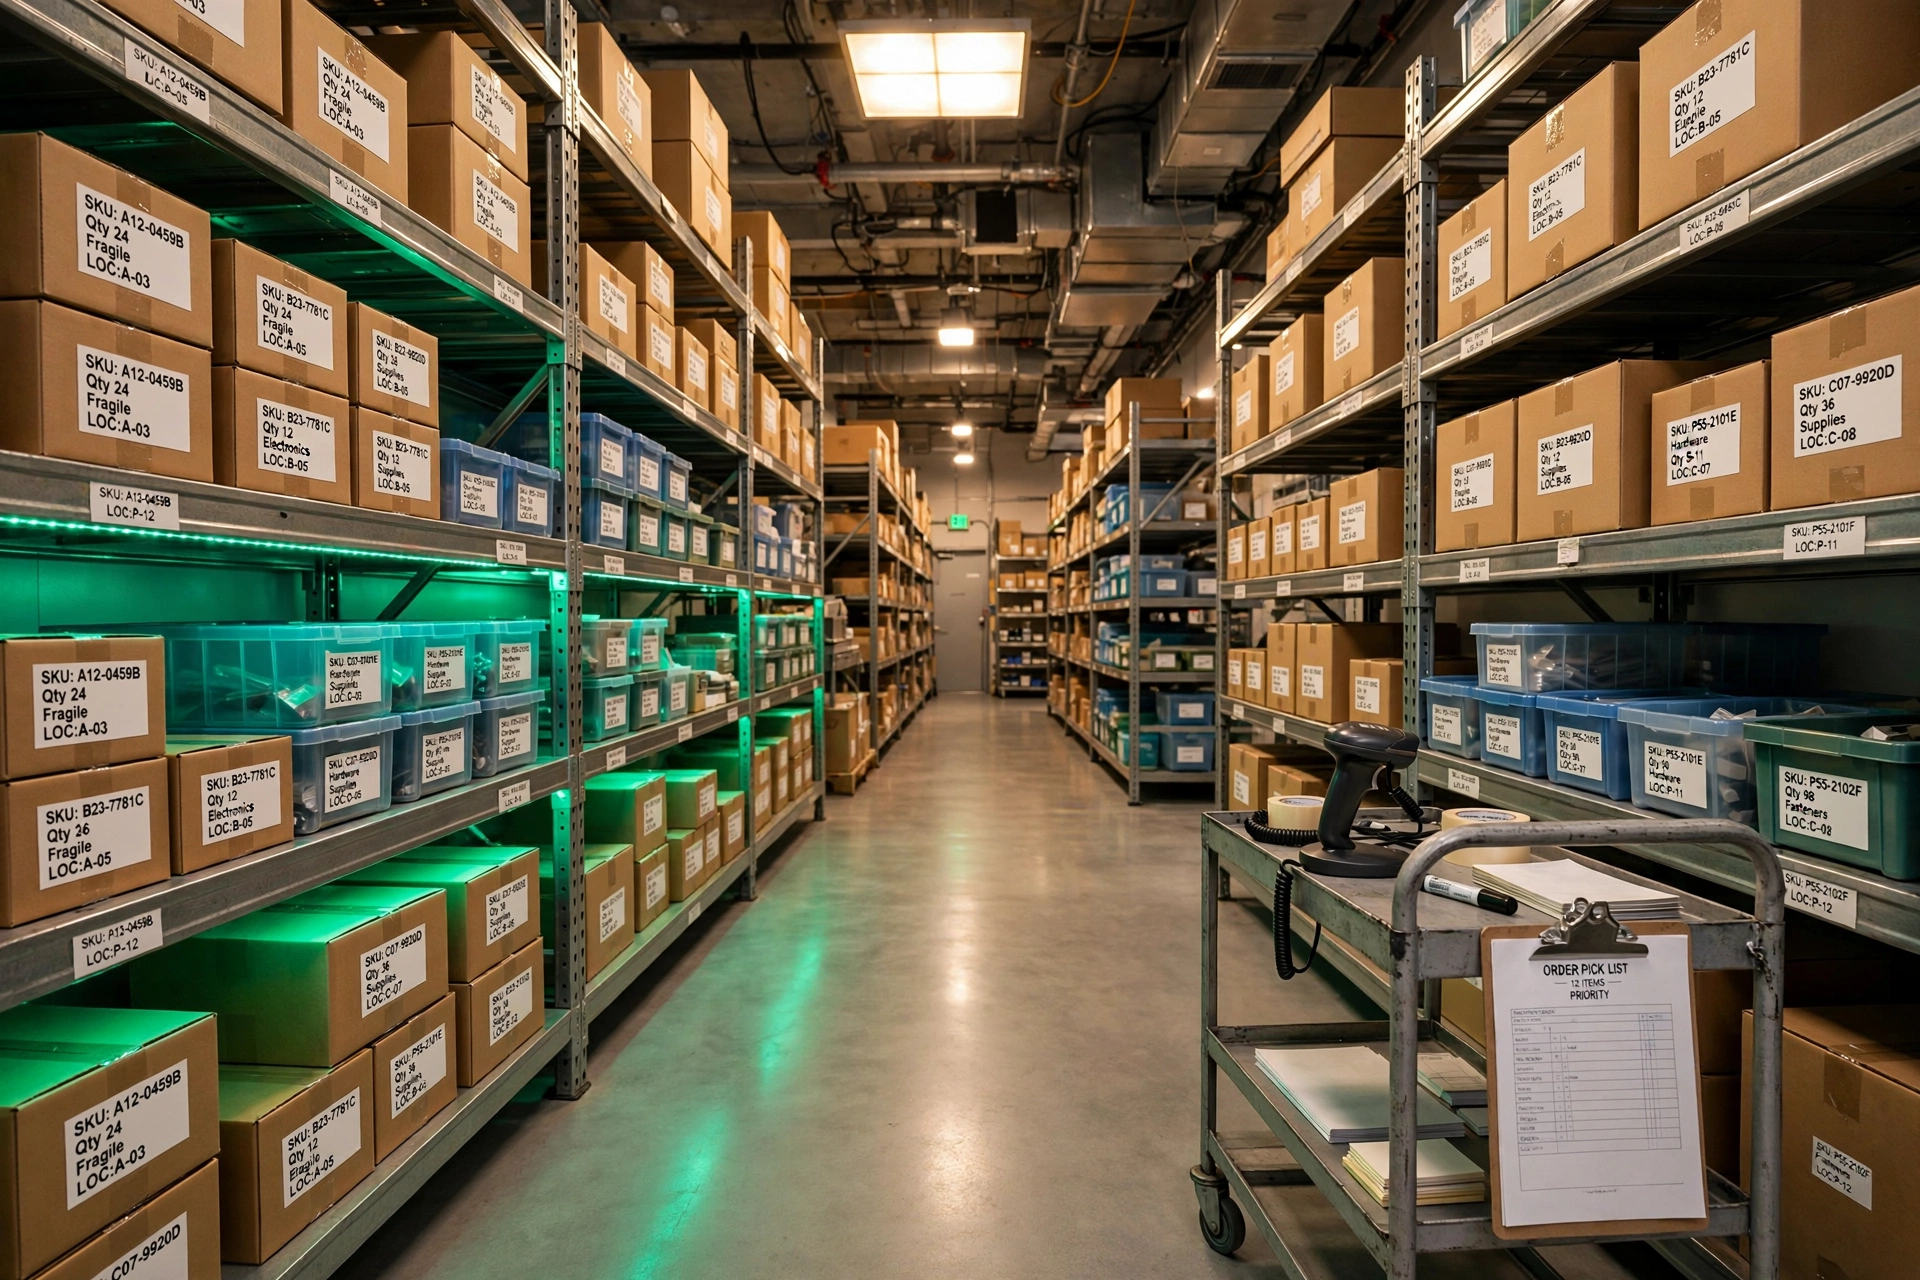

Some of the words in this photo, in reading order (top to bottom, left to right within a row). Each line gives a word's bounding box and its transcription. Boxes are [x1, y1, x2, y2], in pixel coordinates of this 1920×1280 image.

[134, 48, 157, 71] SKU:
[323, 57, 343, 82] SKU:
[1675, 81, 1696, 102] SKU:
[1698, 41, 1750, 86] B23-7781C
[323, 73, 338, 94] Qty
[341, 88, 350, 101] 24
[1694, 90, 1703, 106] 12
[323, 104, 364, 140] LOC:A-03
[1675, 110, 1721, 148] LOC:B-05
[85, 194, 117, 220] SKU:
[121, 211, 184, 248] A12-0459B
[86, 214, 109, 238] Qty
[114, 226, 129, 243] 24
[87, 234, 130, 262] Fragile
[87, 253, 150, 288] LOC:A-03
[262, 283, 285, 302] SKU:
[287, 294, 329, 320] B23-7781C
[262, 300, 278, 317] Qty
[281, 308, 292, 320] 24
[263, 315, 293, 336] Fragile
[263, 331, 306, 355] LOC:A-05
[86, 354, 117, 375] SKU:
[122, 364, 184, 392] A12-0459B
[86, 373, 110, 394] Qty
[115, 381, 129, 396] 24
[1799, 384, 1825, 401] SKU:
[1829, 364, 1894, 392] C07-9920D
[87, 392, 131, 415] Fragile
[1800, 404, 1818, 417] Qty
[1822, 398, 1834, 411] 36
[88, 411, 150, 438] LOC:A-03
[262, 405, 285, 422] SKU:
[288, 412, 330, 433] B23-7781C
[263, 421, 279, 437] Qty
[282, 426, 293, 438] 12
[1800, 414, 1845, 433] Supplies
[1800, 427, 1856, 450] LOC:C-08
[264, 453, 308, 471] LOC:B-05
[392, 454, 399, 464] 12
[1672, 463, 1710, 480] LOC:C-07
[99, 487, 123, 500] SKU:
[107, 505, 155, 521] LOC:P-12
[1796, 540, 1837, 552] LOC:P-11
[41, 669, 74, 684] SKU:
[78, 667, 140, 682] A12-0459B
[42, 689, 66, 705] Qty
[71, 688, 86, 701] 24
[43, 706, 88, 722] Fragile
[44, 721, 107, 740] LOC:A-03
[207, 777, 229, 791] SKU:
[232, 766, 275, 786] B23-7781C
[1650, 782, 1683, 798] LOC:P-11
[1785, 772, 1807, 786] SKU:
[1810, 776, 1862, 797] P55-2102F
[208, 794, 223, 808] Qty
[227, 790, 237, 801] 12
[1785, 786, 1800, 800] Qty
[1803, 790, 1814, 801] 98
[46, 807, 78, 824] SKU:
[83, 793, 144, 818] B23-7781C
[1786, 800, 1828, 819] Fasteners
[47, 828, 70, 843] Qty
[75, 823, 90, 837] 26
[209, 816, 253, 838] LOC:B-05
[48, 841, 91, 861] Fragile
[49, 852, 111, 881] LOC:A-05
[1785, 873, 1804, 887] SKU:
[1806, 879, 1848, 901] P55-2102F
[1791, 889, 1832, 914] LOC:P-12
[82, 933, 105, 949] SKU:
[87, 938, 138, 966] LOC:P-12
[365, 952, 384, 967] SKU:
[1543, 965, 1579, 976] ORDER
[1582, 964, 1604, 975] PICK
[1608, 963, 1628, 974] LIST
[1582, 979, 1605, 987] ITEMS
[367, 980, 403, 1010] LOC:C-07
[1570, 990, 1609, 1000] PRIORITY
[74, 1109, 109, 1137] SKU:
[114, 1069, 181, 1117] A12-0459B
[288, 1130, 310, 1151] SKU:
[312, 1096, 356, 1135] B23-7781C
[75, 1133, 101, 1156] Qty
[107, 1120, 122, 1140] 24
[77, 1141, 124, 1176] Fragile
[289, 1150, 305, 1165] Qty
[307, 1138, 318, 1153] 12
[78, 1145, 145, 1196] LOC:A-03
[290, 1156, 334, 1198] LOC:A-05
[112, 1224, 180, 1280] C07-9920D
